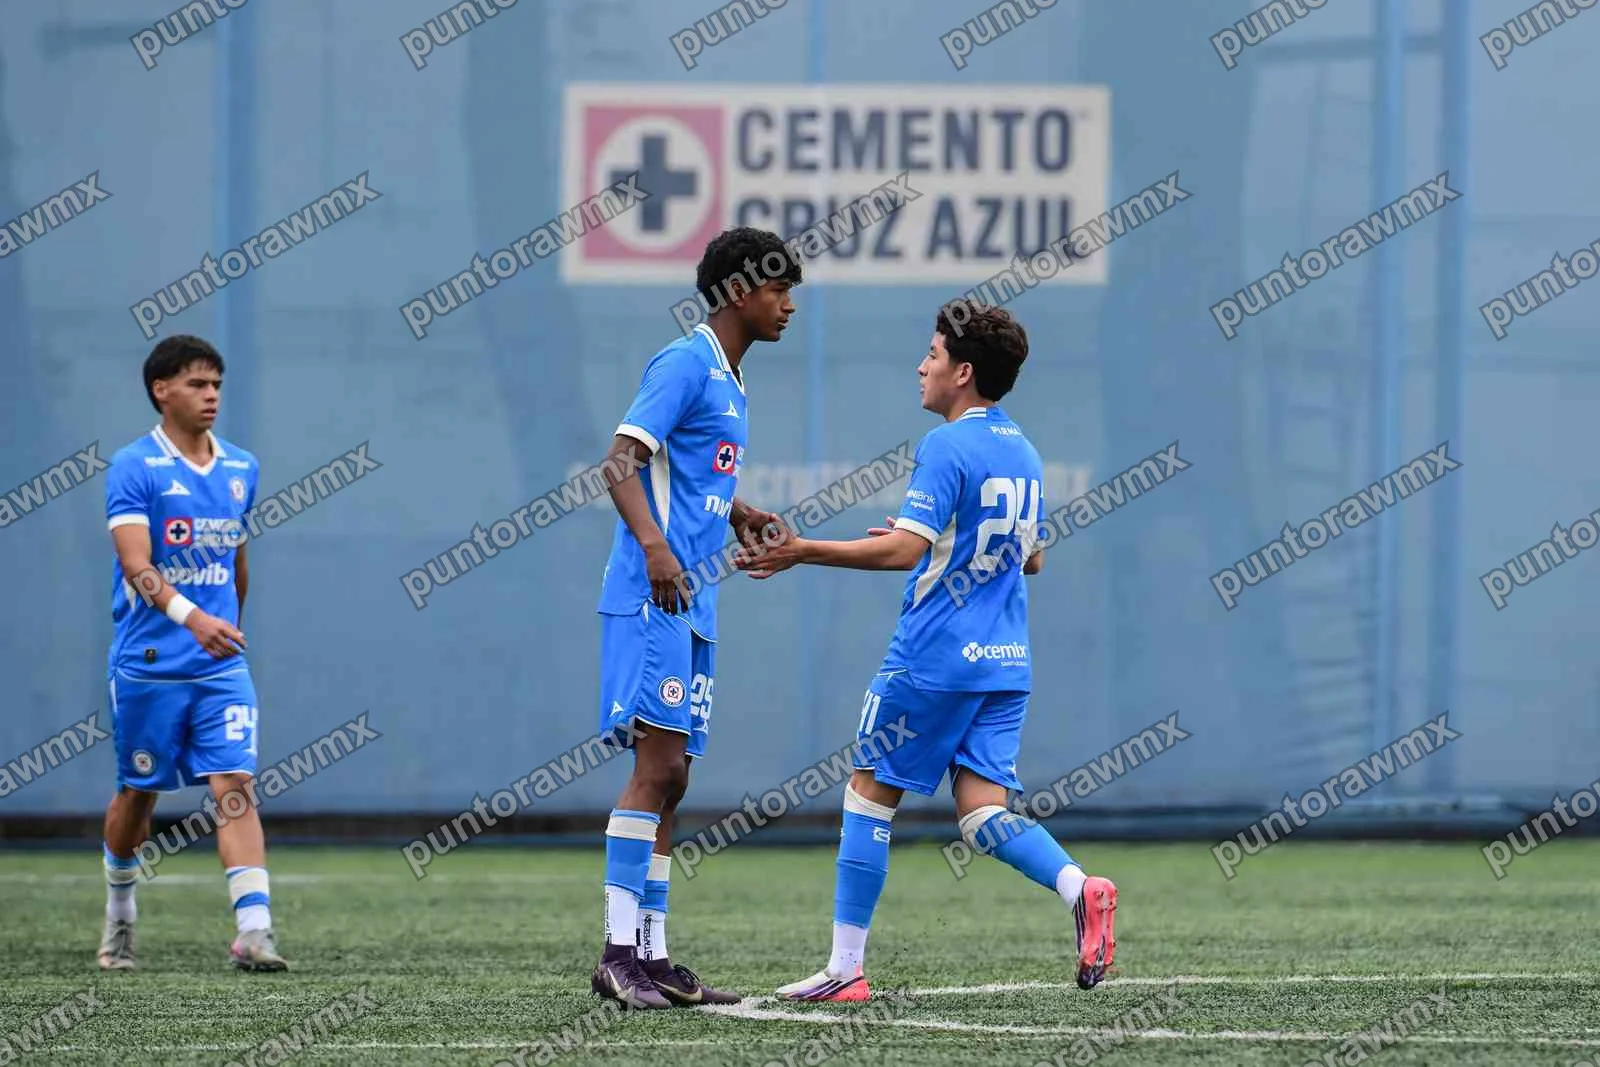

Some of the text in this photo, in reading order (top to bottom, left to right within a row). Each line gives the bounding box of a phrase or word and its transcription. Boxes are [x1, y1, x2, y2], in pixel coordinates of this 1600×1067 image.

[736, 108, 1073, 173] CEMENTO
[736, 194, 1093, 259] CRUZ AZUL
[984, 641, 1026, 659] cemix
